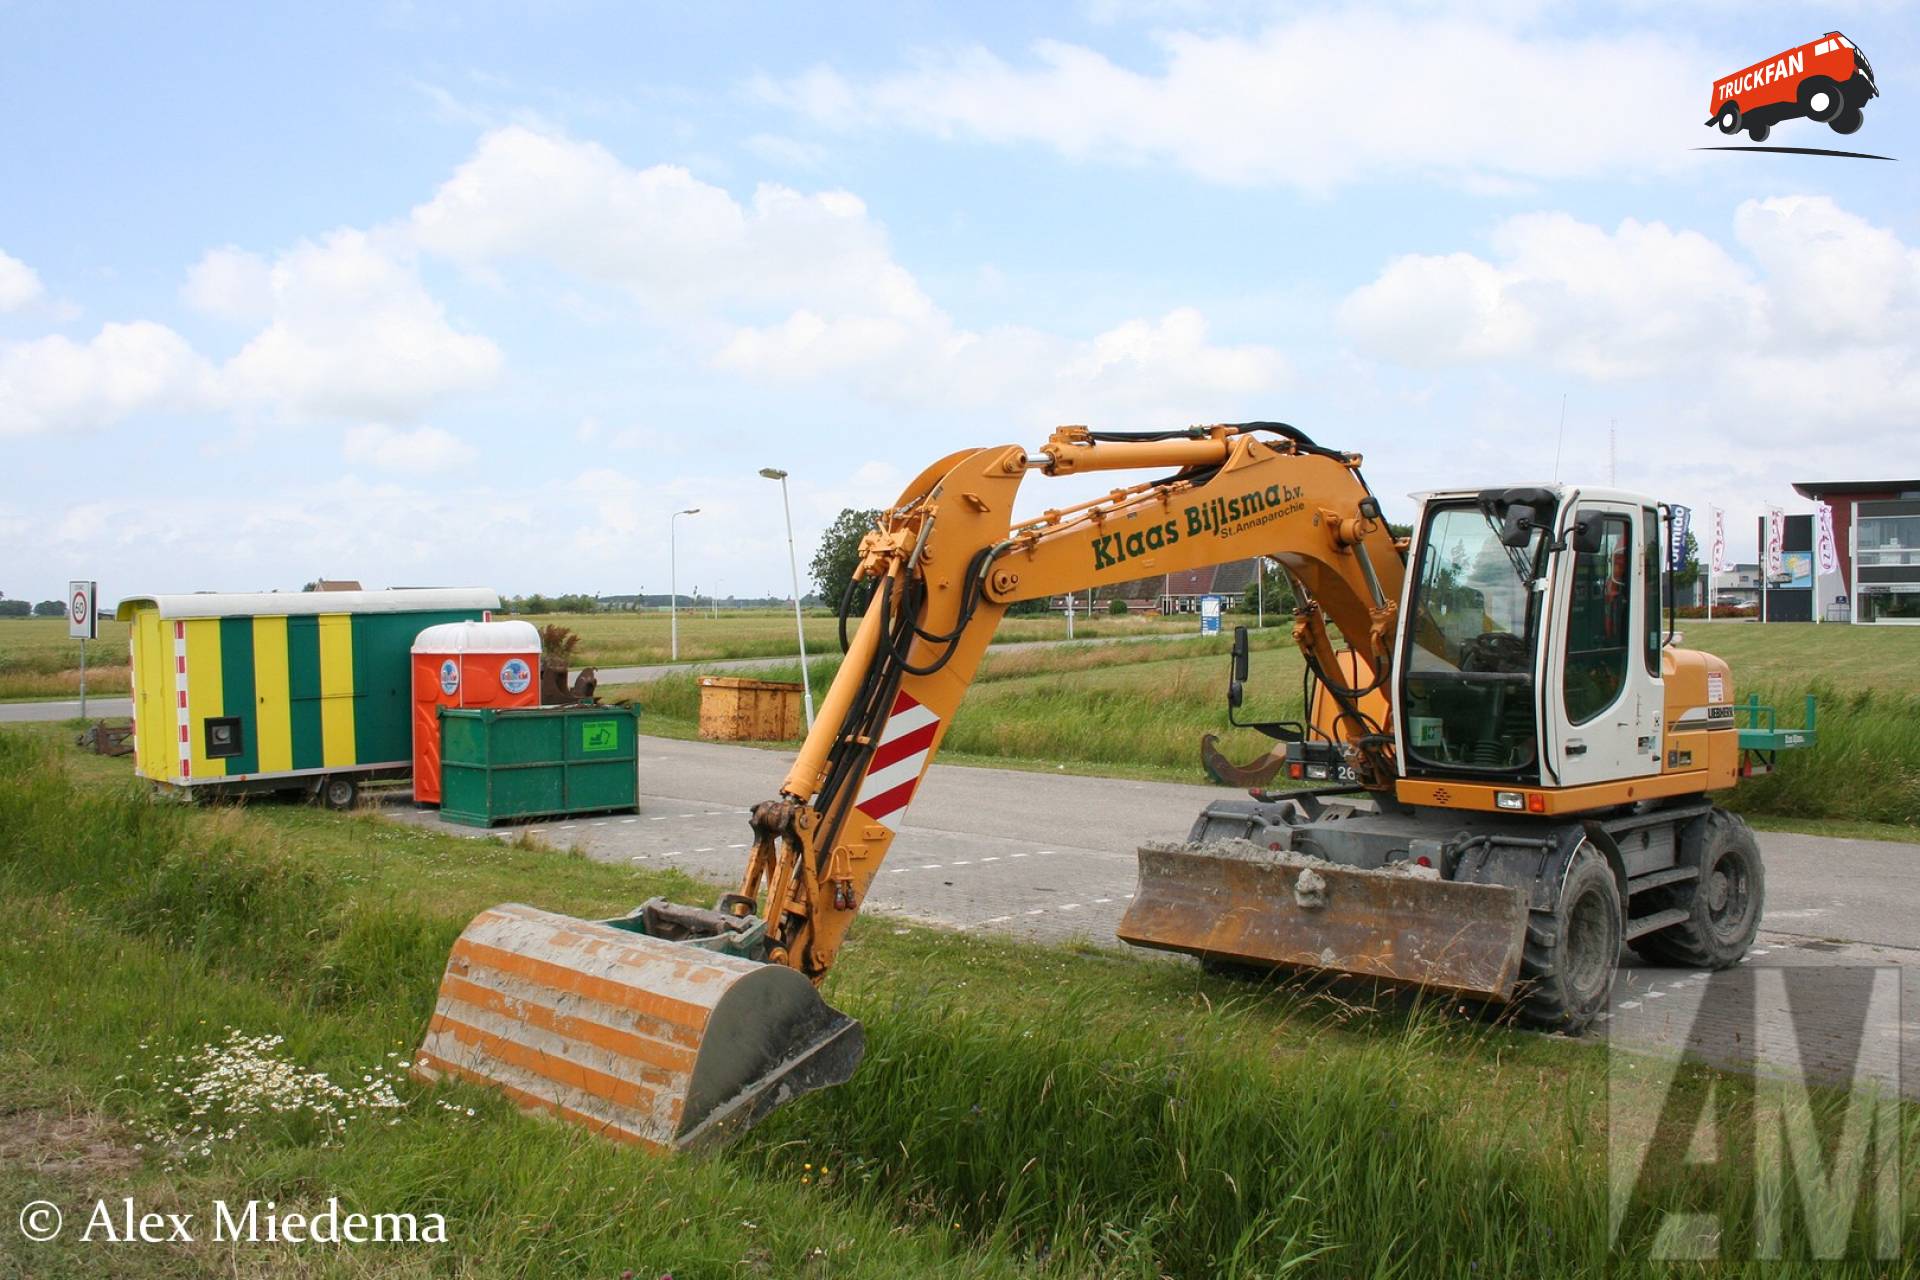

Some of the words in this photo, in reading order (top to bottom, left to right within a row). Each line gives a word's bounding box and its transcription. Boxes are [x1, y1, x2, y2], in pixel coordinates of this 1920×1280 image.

[1091, 519, 1180, 570] Klaas
[1184, 484, 1281, 537] Bijlsma
[1283, 485, 1304, 502] b.v.
